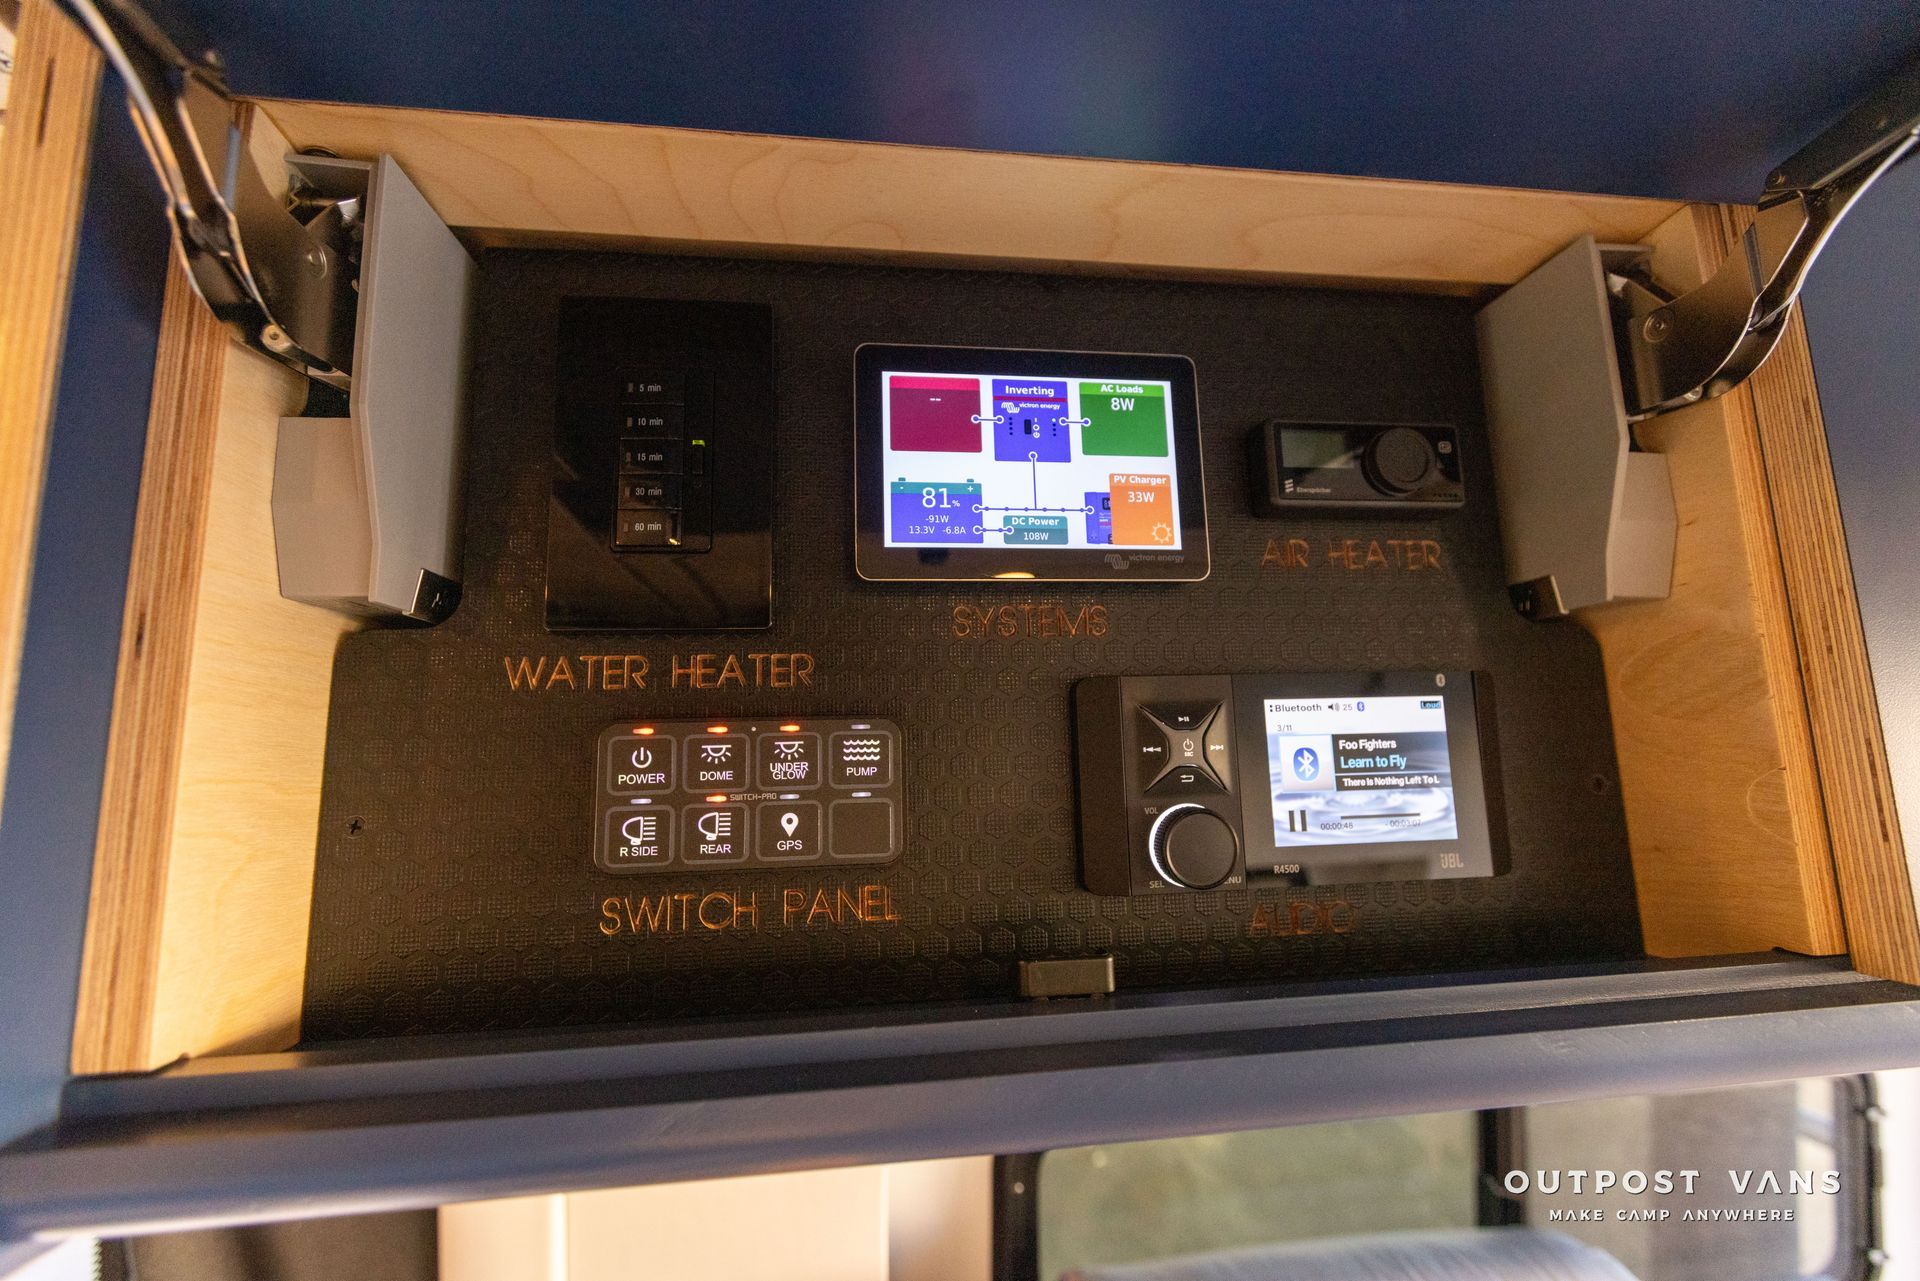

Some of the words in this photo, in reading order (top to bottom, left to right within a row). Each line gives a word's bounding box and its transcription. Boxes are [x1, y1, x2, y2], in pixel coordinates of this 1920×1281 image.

[639, 382, 645, 393] 5
[647, 382, 662, 393] min
[1005, 385, 1055, 397] Inverting
[1101, 384, 1113, 393] AC
[1116, 384, 1144, 394] Loads
[1110, 397, 1135, 411] 8W
[638, 416, 647, 427] 10
[649, 416, 664, 427] min
[637, 451, 646, 462] 15
[648, 451, 663, 462] min
[1113, 475, 1127, 484] PV
[1129, 475, 1167, 486] Charger
[635, 486, 645, 497] 30
[647, 486, 662, 497] min
[1127, 491, 1155, 503] 33W
[925, 515, 950, 524] -91W
[1011, 516, 1025, 526] DC
[1028, 517, 1060, 527] Power
[634, 521, 645, 532] 60
[647, 521, 662, 532] min
[908, 525, 936, 535] 13.3V
[942, 526, 967, 535] -6.8A
[1023, 531, 1050, 541] 108W
[1128, 553, 1156, 562] victron
[1157, 554, 1185, 564] energy
[1261, 539, 1310, 569] AIR
[1327, 539, 1442, 571] HEATER
[952, 605, 1109, 638] SYSTEMS
[504, 655, 650, 692] WATER
[671, 653, 816, 690] HEATER
[1275, 703, 1322, 712] Bluetooth
[1420, 701, 1441, 709] Loud
[1338, 740, 1358, 750] Foo
[1359, 739, 1397, 751] Fighters
[770, 762, 809, 772] UNDER
[1340, 757, 1373, 769] Learn
[1376, 757, 1388, 768] to
[1390, 755, 1407, 769] Fly
[700, 771, 733, 781] DOME
[773, 770, 806, 780] GLOW
[846, 767, 877, 777] PUMP
[618, 774, 665, 785] POWER
[1342, 777, 1366, 787] There
[1374, 776, 1405, 787] Nothing
[1405, 774, 1422, 785] Left
[1423, 773, 1434, 784] To
[1145, 807, 1158, 815] VOL
[700, 844, 731, 854] REAR
[777, 840, 802, 851] GPS
[619, 848, 628, 857] R
[631, 846, 658, 856] SIDE
[1274, 864, 1300, 874] R4500
[1149, 881, 1164, 889] SEL
[599, 892, 759, 935] SWITCH
[783, 884, 901, 926] PANEL
[1251, 901, 1354, 936] AUDIO
